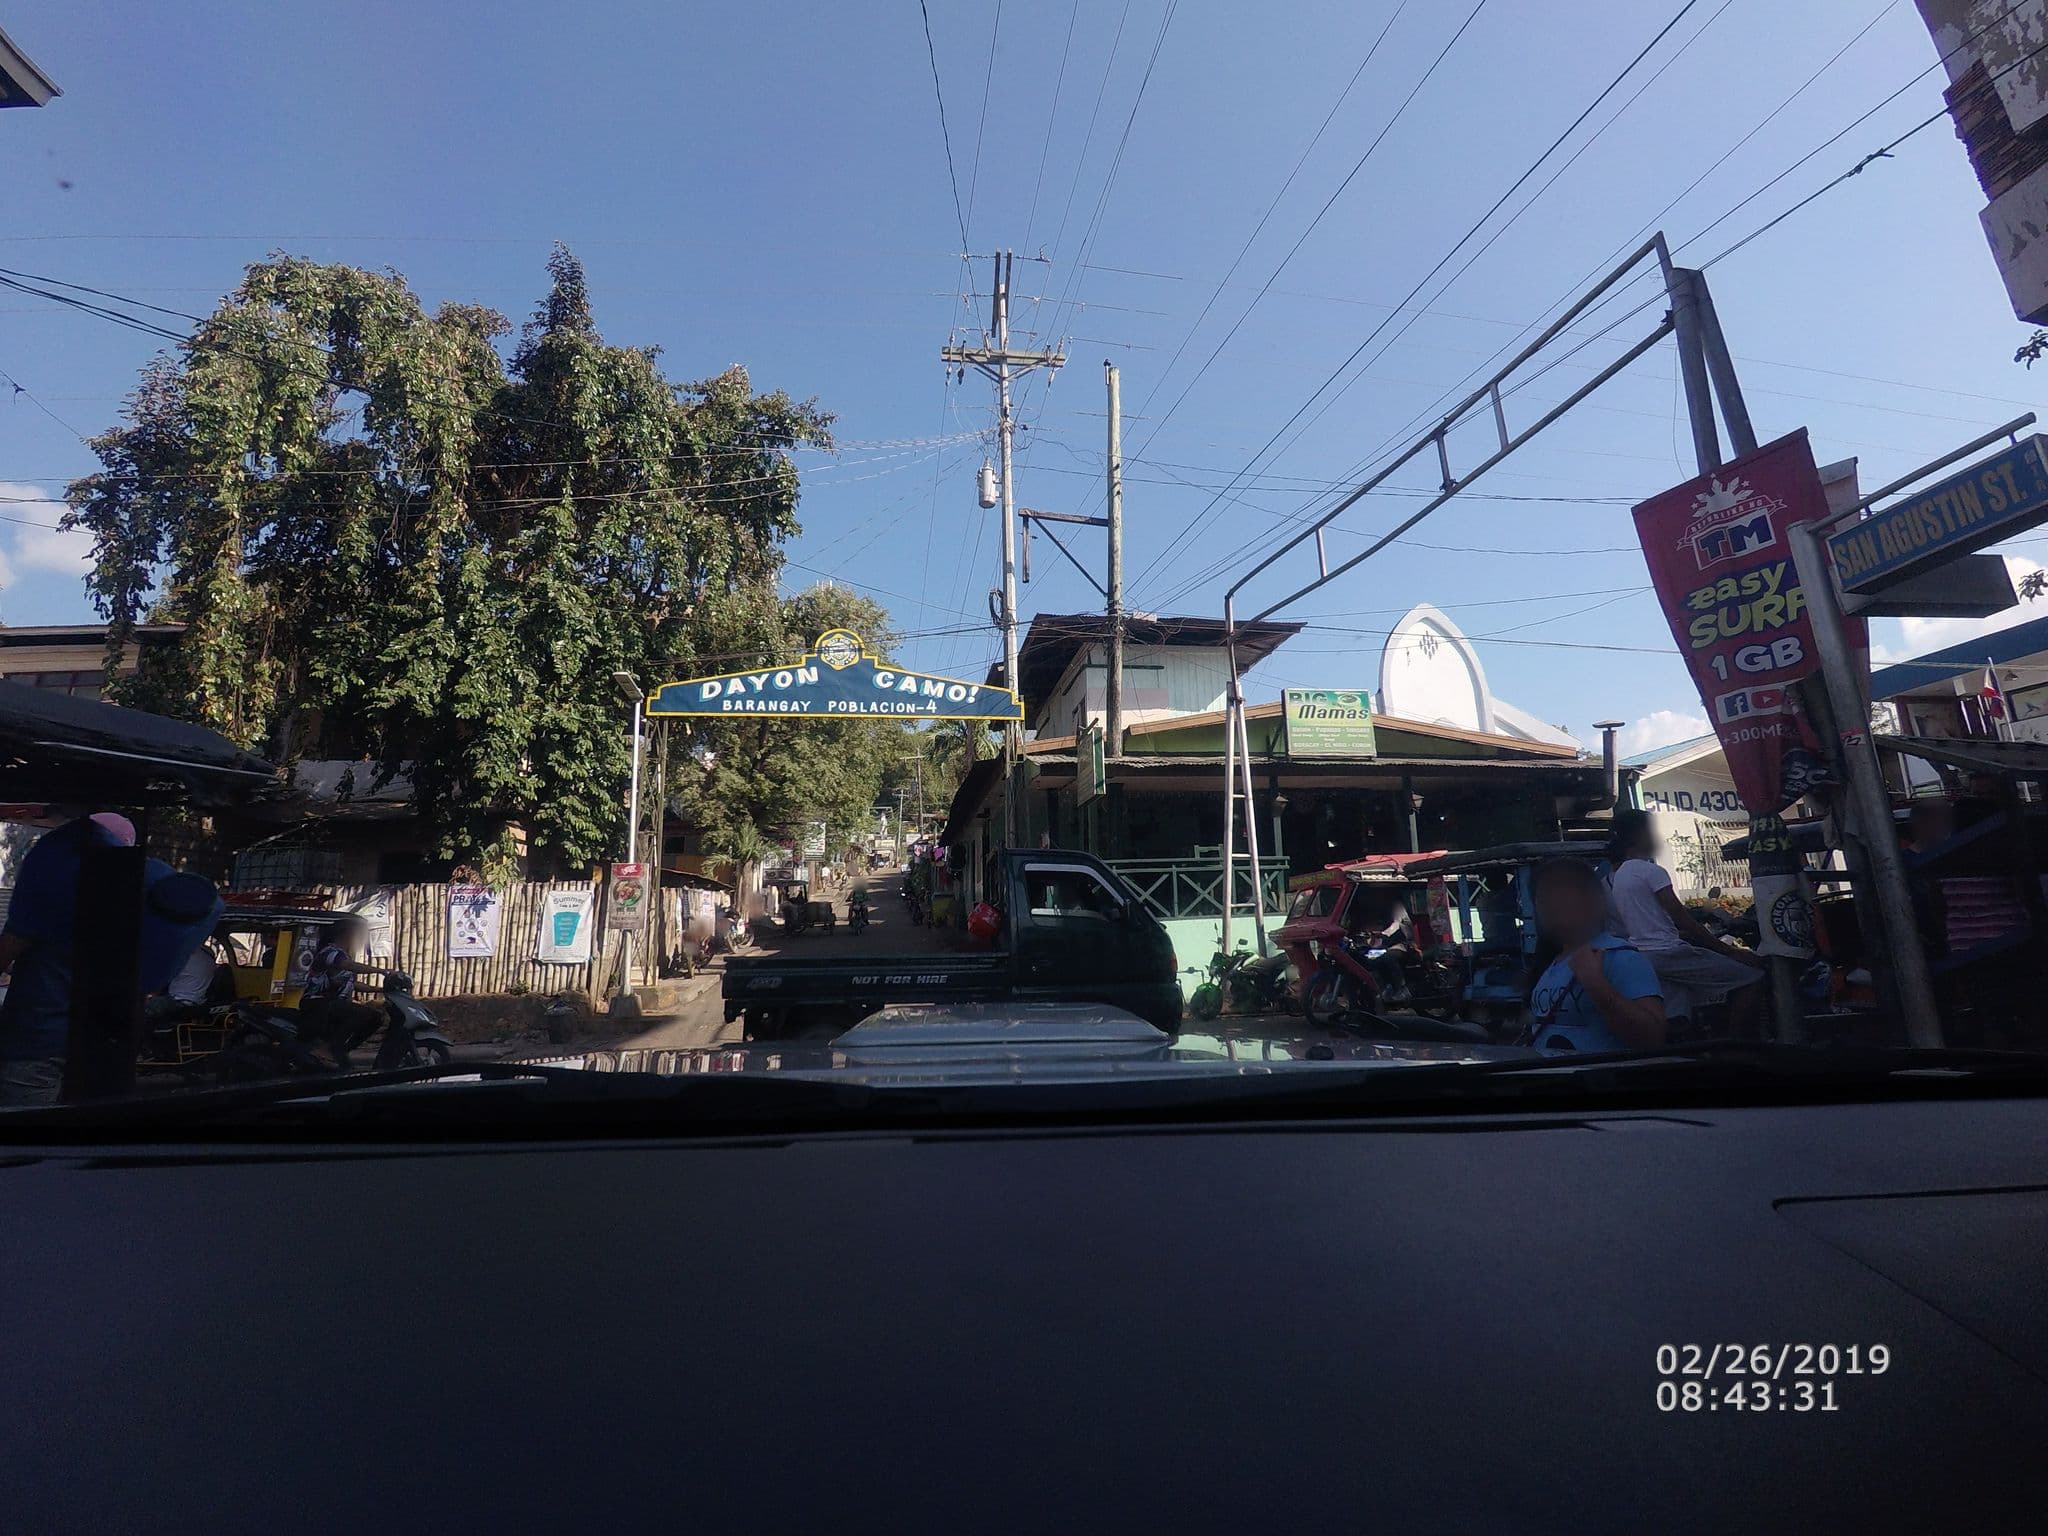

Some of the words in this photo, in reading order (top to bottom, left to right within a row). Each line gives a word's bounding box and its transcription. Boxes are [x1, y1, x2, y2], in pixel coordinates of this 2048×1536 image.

[1698, 513, 1775, 560] TM
[1834, 529, 1880, 579] SAN
[1878, 480, 1985, 562] AGUSTIN
[1982, 462, 2028, 513] ST.
[1687, 562, 1787, 610] easy
[700, 666, 819, 700] DAYON
[873, 671, 980, 704] CAMO!
[722, 700, 811, 712] BARANGAY
[828, 699, 938, 714] POBLACION-4
[851, 975, 880, 984] NOT
[885, 975, 911, 984] FOR
[917, 974, 948, 984] HIRE
